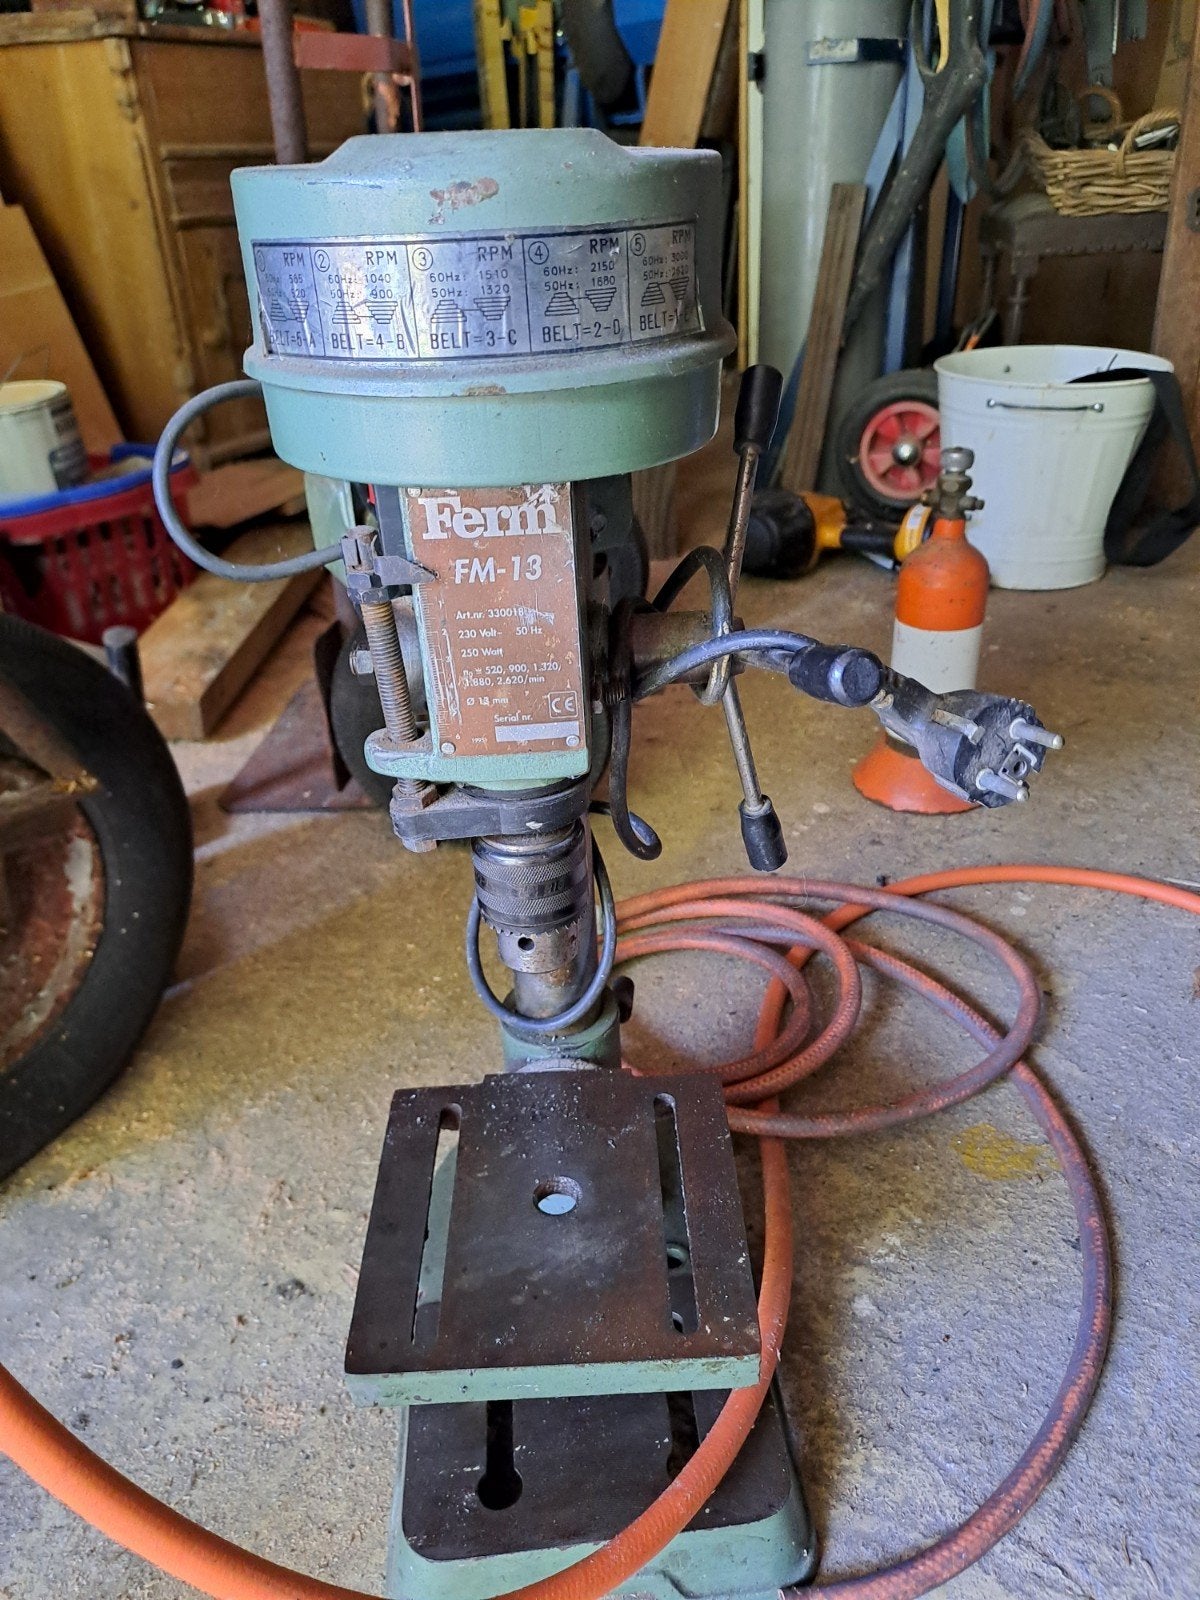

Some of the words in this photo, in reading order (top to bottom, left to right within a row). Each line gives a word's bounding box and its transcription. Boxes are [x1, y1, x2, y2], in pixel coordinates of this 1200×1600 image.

[672, 229, 691, 245] RPM
[477, 245, 513, 262] RPM
[589, 237, 619, 255] RPM
[282, 252, 306, 267] RPM
[365, 250, 398, 266] RPM
[429, 272, 467, 283] 60Hz:
[479, 268, 509, 280] 1510
[543, 265, 579, 277] 60Hz:
[590, 260, 615, 273] 2150
[364, 273, 392, 284] 1040
[544, 280, 580, 292] 50Hz:
[431, 287, 469, 298] 50Hz:
[481, 283, 511, 296] 1320
[418, 497, 563, 540] Ferm
[454, 553, 543, 585] FM-13
[458, 629, 477, 639] 230
[515, 626, 528, 636] 50
[530, 626, 543, 635] Hz
[461, 648, 479, 658] 250
[481, 647, 504, 657] Watt
[485, 665, 506, 675] 520,
[508, 664, 530, 674] 900,
[496, 674, 546, 686] 2.620/min
[551, 697, 576, 714] CE
[493, 713, 520, 723] Serial
[521, 714, 534, 722] nr.
